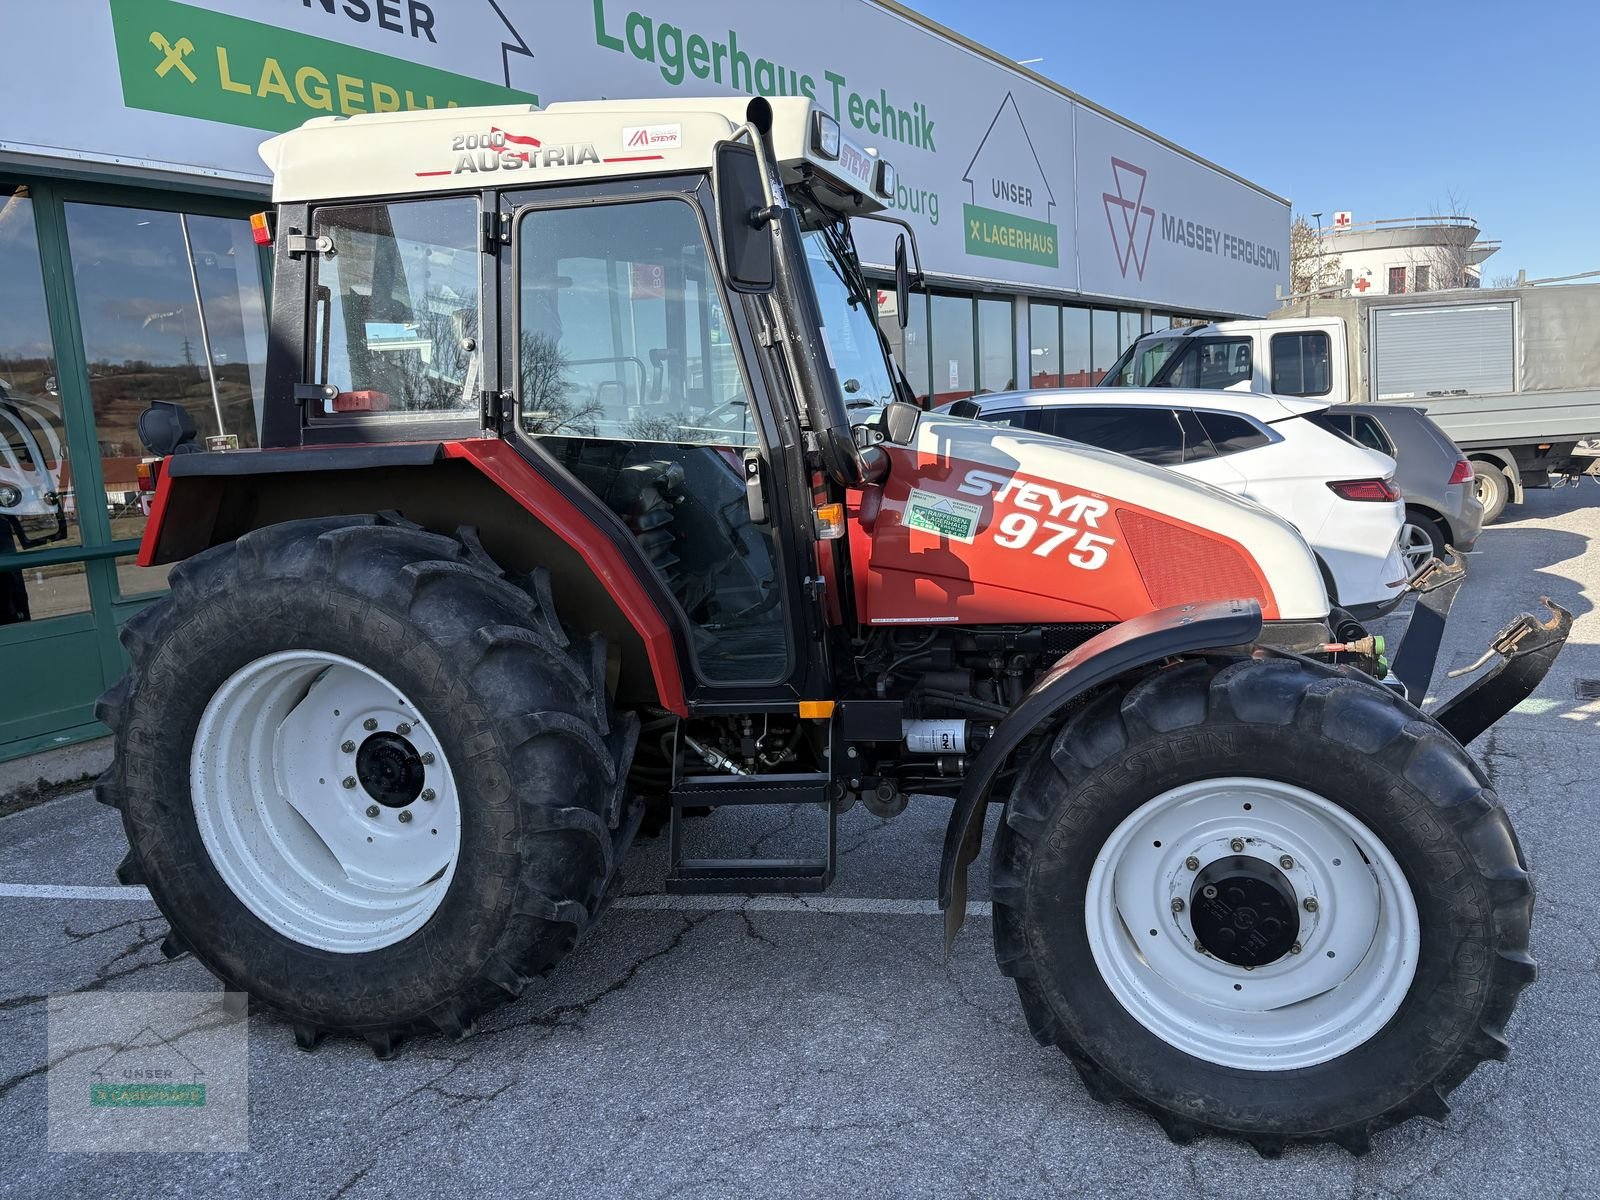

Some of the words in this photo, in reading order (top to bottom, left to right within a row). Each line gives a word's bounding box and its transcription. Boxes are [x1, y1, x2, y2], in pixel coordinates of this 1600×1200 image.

[303, 0, 437, 43] SER
[593, 0, 817, 101] Lagerhaus
[824, 70, 937, 153] Technik
[452, 129, 506, 152] 2000
[453, 143, 600, 175] AUSTRIA
[650, 134, 678, 143] STEYR
[840, 143, 872, 183] STEYR
[888, 173, 940, 226] burg
[991, 177, 1033, 208] UNSER
[982, 222, 1054, 255] LAGERHAUS
[1160, 212, 1221, 252] MASSEY
[1222, 233, 1281, 272] FERGUSON
[956, 468, 1109, 529] STEYR
[993, 512, 1116, 570] 975
